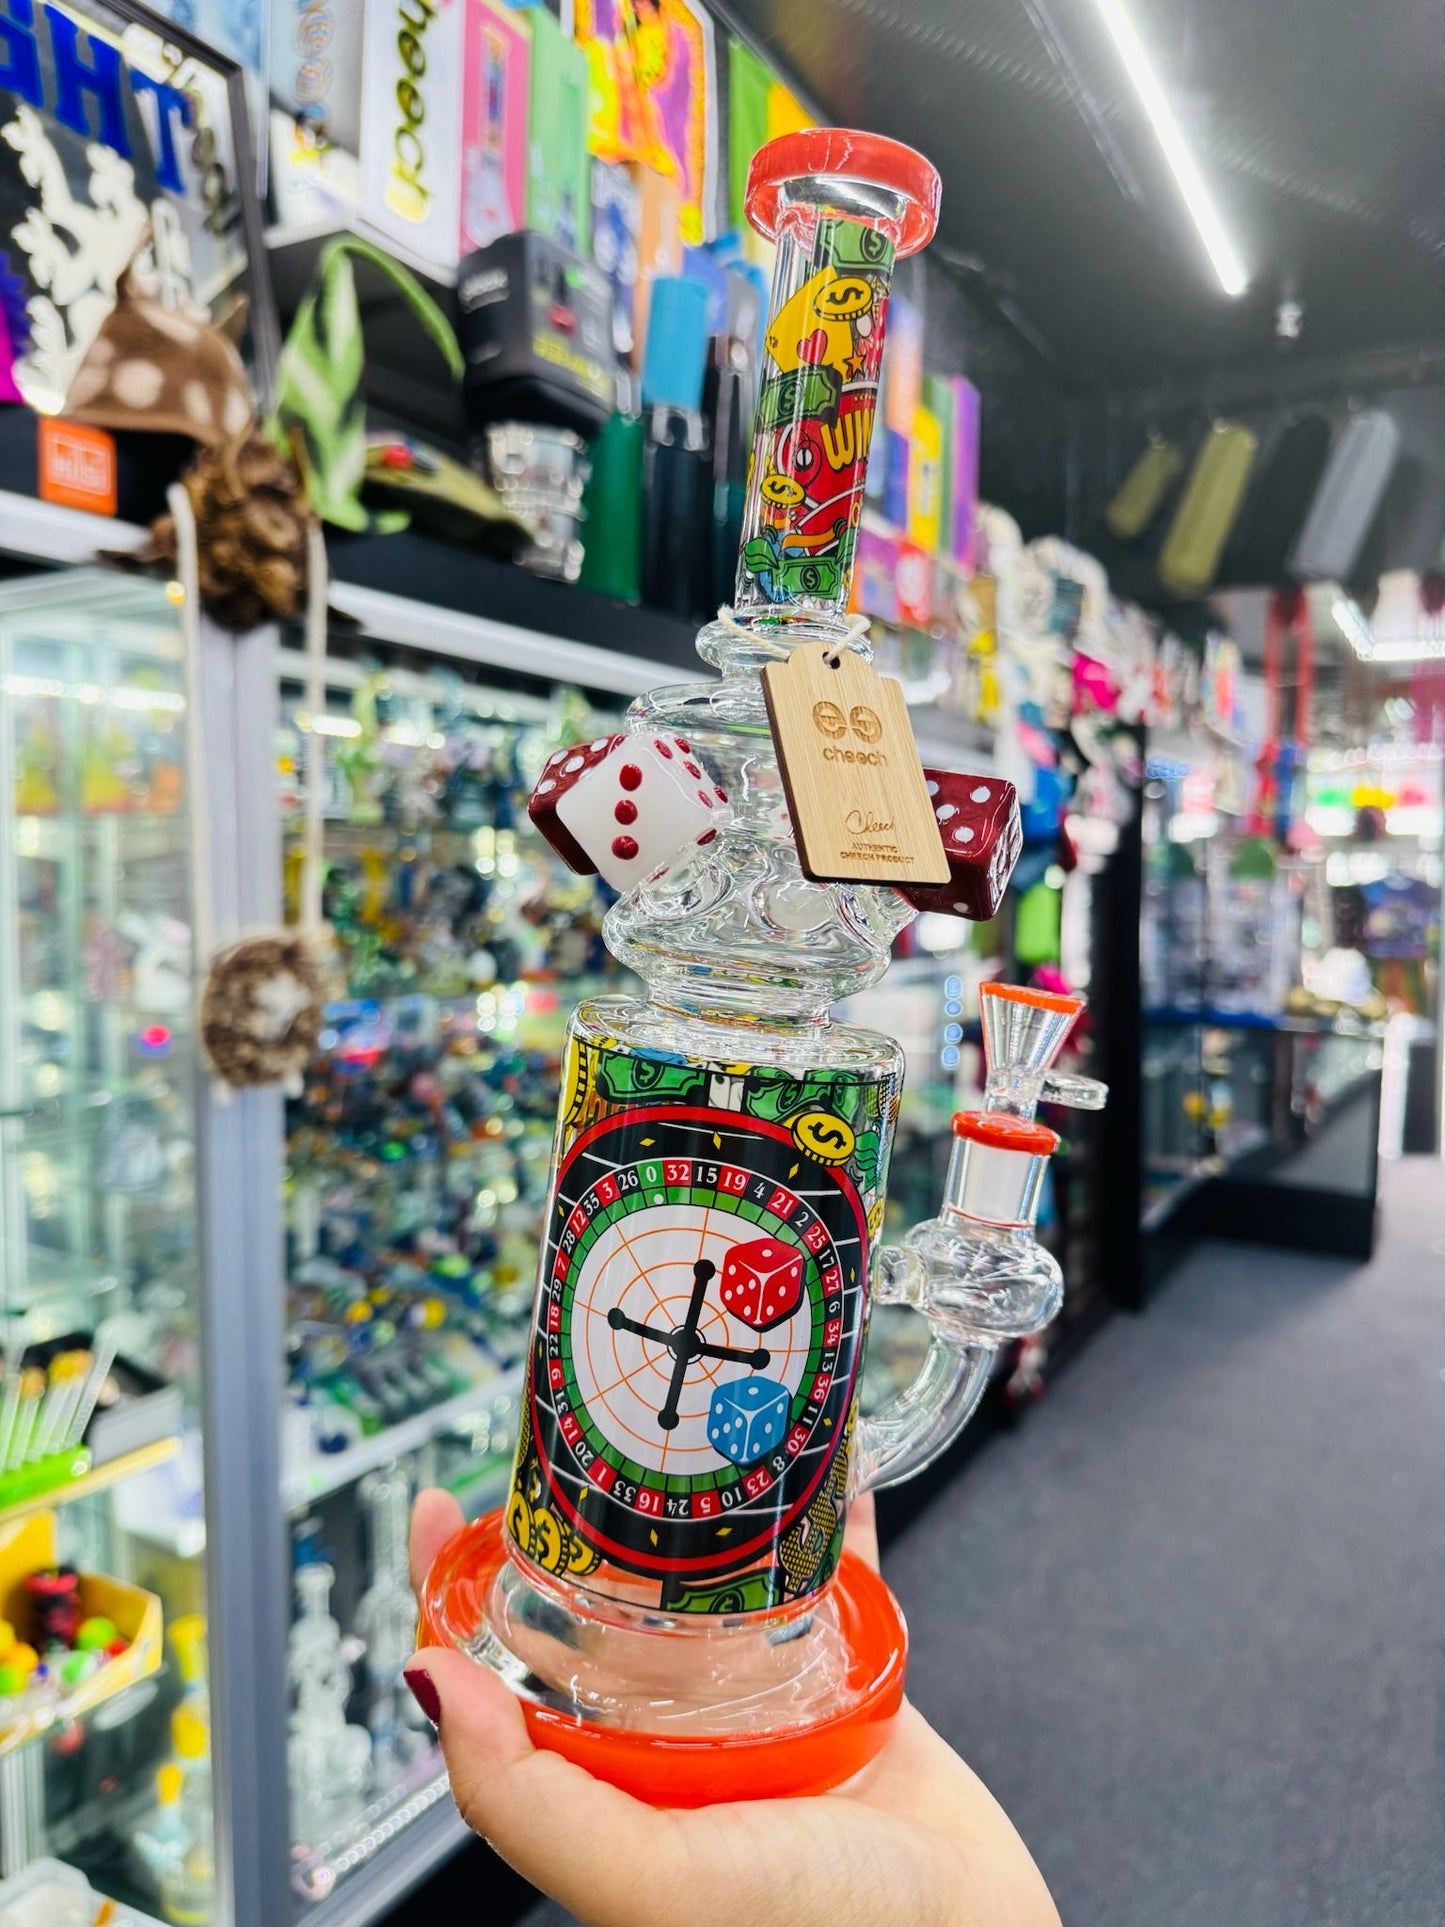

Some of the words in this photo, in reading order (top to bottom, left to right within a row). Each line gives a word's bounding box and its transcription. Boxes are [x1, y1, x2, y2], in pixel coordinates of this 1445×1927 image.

[385, 0, 437, 222] heech
[823, 746, 888, 765] cheech
[851, 842, 898, 854] AUTHENTIC
[877, 854, 914, 865] PRODUCT
[617, 1170, 639, 1191] 26
[645, 1165, 657, 1183] 0
[667, 1163, 690, 1182] 32
[696, 1166, 718, 1184] 15
[723, 1171, 746, 1191] 19
[602, 1182, 613, 1199] 3
[754, 1182, 765, 1199] 4
[583, 1192, 600, 1216] 35
[771, 1191, 794, 1215] 21
[572, 1213, 588, 1233] 12
[795, 1211, 809, 1228] 2
[562, 1230, 576, 1254] 28
[807, 1226, 826, 1250] 25
[557, 1260, 567, 1272] 7
[819, 1249, 835, 1269] 17
[552, 1280, 562, 1301] 29
[826, 1270, 840, 1291] 27
[550, 1305, 560, 1327] 18
[828, 1300, 840, 1313] 6
[827, 1322, 840, 1345] 34
[550, 1334, 559, 1356] 22
[822, 1351, 835, 1372] 13
[551, 1369, 562, 1380] 9
[813, 1376, 829, 1400] 36
[555, 1386, 570, 1413] 31
[802, 1405, 818, 1425] 11
[563, 1417, 579, 1441] 14
[787, 1428, 806, 1452] 30
[575, 1441, 595, 1465] 20
[772, 1455, 786, 1471] 8
[597, 1468, 608, 1482] 1
[747, 1470, 770, 1495] 23
[613, 1480, 637, 1503] 33
[721, 1487, 742, 1507] 10
[638, 1492, 660, 1512] 16
[666, 1498, 689, 1516] 24
[700, 1497, 711, 1515] 5
